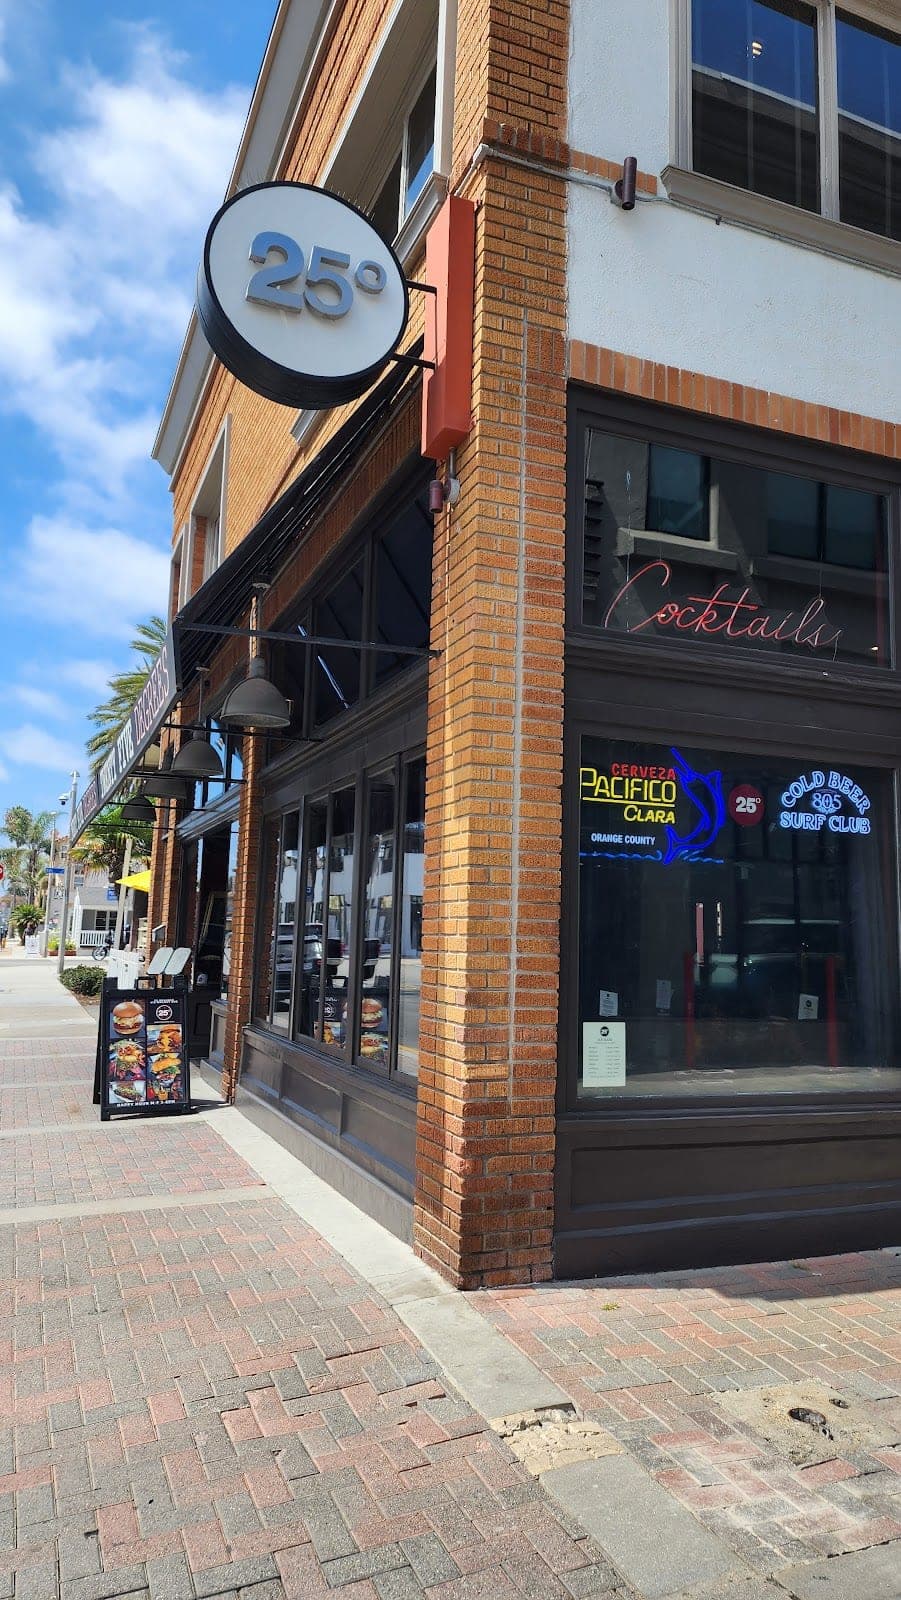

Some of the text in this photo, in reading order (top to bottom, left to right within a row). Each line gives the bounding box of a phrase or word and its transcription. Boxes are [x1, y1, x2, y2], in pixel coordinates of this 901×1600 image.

[604, 561, 842, 648] Cocktails
[117, 717, 135, 774] FIVE
[133, 646, 171, 747] DEGREES
[611, 763, 676, 780] CERVEZA
[579, 767, 677, 804] PACIFICO
[781, 770, 871, 815] COLD BEER
[812, 792, 842, 810] 805
[623, 804, 676, 824] CLARA
[780, 811, 871, 835] SURF CLUB
[590, 832, 656, 846] ORANGE COUNTY
